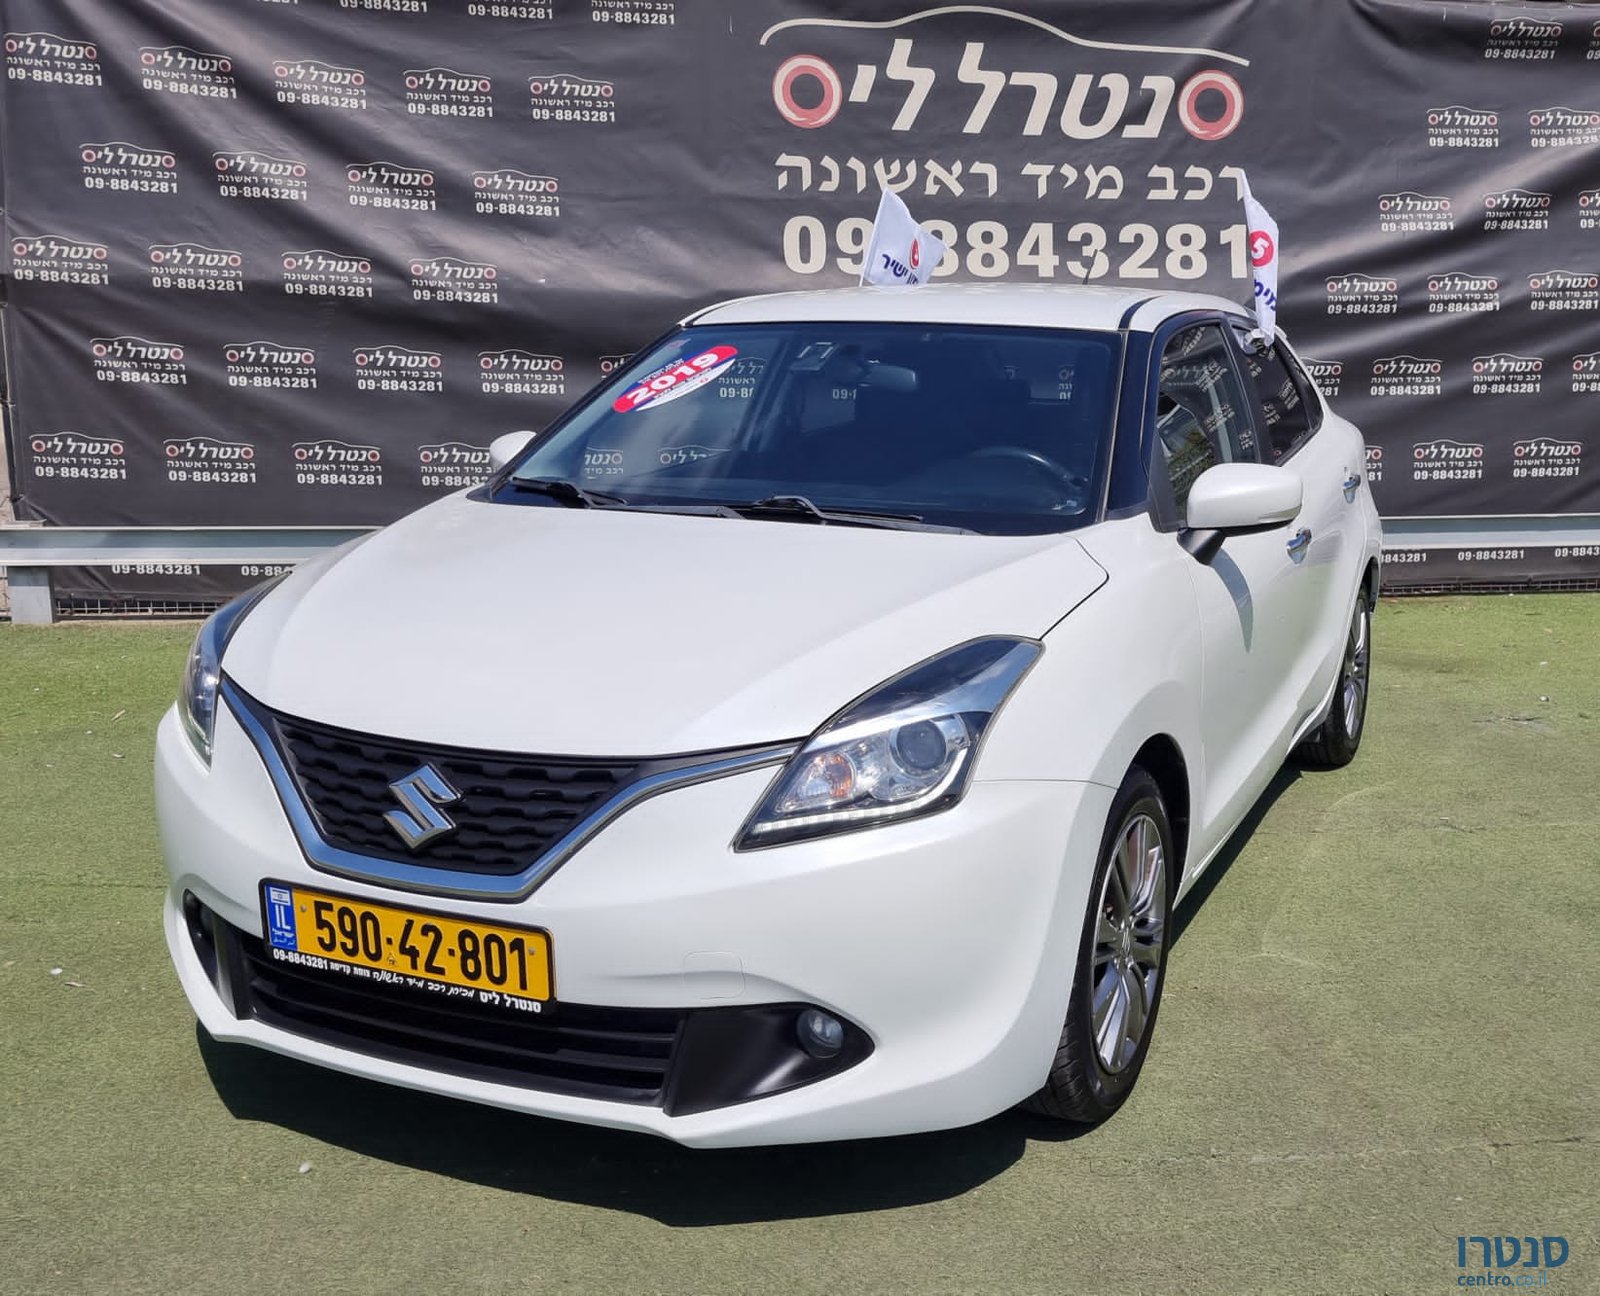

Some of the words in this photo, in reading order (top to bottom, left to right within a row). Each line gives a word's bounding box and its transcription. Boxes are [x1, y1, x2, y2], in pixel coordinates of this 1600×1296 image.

[467, 4, 553, 20] 09-8843281
[592, 10, 675, 25] 09-8843281
[1485, 48, 1555, 59] 09-8843281
[6, 56, 50, 67] ראשונה
[54, 60, 76, 69] מיד
[80, 62, 100, 71] רכב
[7, 67, 102, 86] 09-8843281
[142, 77, 237, 99] 09-8843281
[276, 90, 366, 109] 09-8843281
[406, 92, 447, 101] ראשונה
[450, 94, 470, 102] מיד
[473, 95, 492, 103] רכב
[530, 97, 570, 106] ראשונה
[573, 99, 592, 107] מיד
[595, 100, 614, 108] רכב
[408, 102, 493, 117] 09-8843281
[532, 108, 615, 122] 09-8843281
[1429, 136, 1499, 147] 09-8843281
[83, 166, 127, 176] ראשונה
[130, 169, 152, 178] מיד
[156, 170, 177, 179] רכב
[775, 152, 998, 198] ראשונה
[84, 176, 177, 193] 09-8843281
[1021, 162, 1124, 200] מיד
[1147, 164, 1247, 201] רכב
[220, 185, 306, 200] 09-8843281
[474, 191, 514, 200] ראשונה
[518, 194, 537, 202] מיד
[349, 194, 436, 211] 09-8843281
[540, 195, 559, 203] רכב
[476, 201, 559, 216] 09-8843281
[1381, 221, 1454, 231] 09-8843281
[1483, 219, 1548, 229] 09-8843281
[13, 258, 58, 267] ראשונה
[61, 261, 83, 269] מיד
[86, 262, 108, 270] רכב
[13, 268, 109, 285] 09-8843281
[152, 276, 243, 291] 09-8843281
[285, 282, 372, 297] 09-8843281
[413, 289, 498, 304] 09-8843281
[1327, 303, 1397, 314] 09-8843281
[1428, 300, 1500, 313] 09-8843281
[1530, 299, 1599, 310] 09-8843281
[94, 359, 138, 368] ראשונה
[141, 362, 161, 370] מיד
[227, 365, 269, 373] ראשונה
[272, 366, 292, 374] מיד
[296, 367, 316, 375] רכב
[96, 369, 187, 384] 09-8843281
[229, 375, 317, 388] 09-8843281
[480, 372, 520, 380] ראשונה
[626, 353, 719, 405] 2019
[357, 379, 442, 391] 09-8843281
[482, 382, 564, 394] 09-8843281
[1370, 384, 1441, 395] 09-8843281
[1472, 382, 1540, 394] 09-8843281
[33, 455, 77, 464] ראשונה
[80, 457, 101, 465] מיד
[167, 460, 208, 468] ראשונה
[211, 461, 232, 469] מיד
[35, 465, 126, 479] 09-8843281
[295, 463, 336, 471] ראשונה
[362, 464, 381, 472] רכב
[1513, 466, 1579, 477] 09-8843281
[168, 470, 256, 483] 09-8843281
[297, 473, 382, 485] 09-8843281
[1413, 468, 1482, 480] 09-8843281
[1457, 550, 1525, 561] 09-8843281
[112, 564, 200, 575] 09-8843281
[275, 902, 291, 930] IL
[503, 993, 541, 1013] סנטרל
